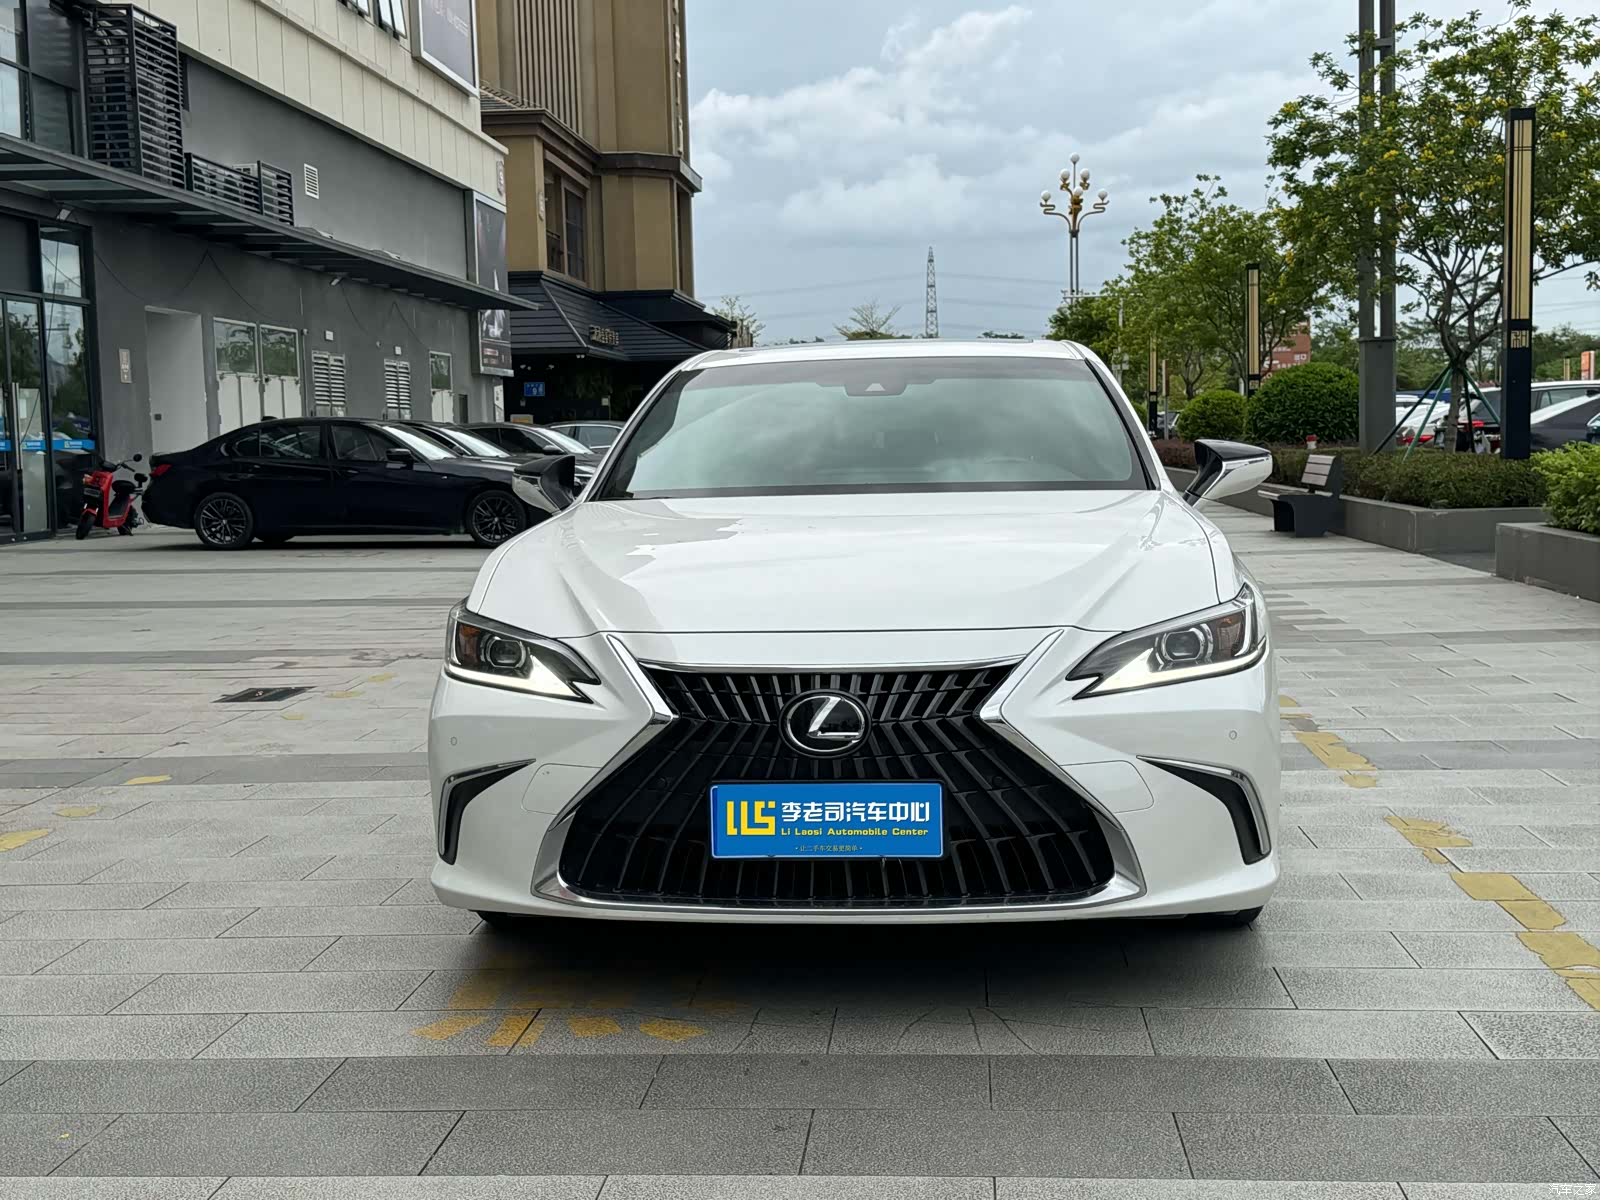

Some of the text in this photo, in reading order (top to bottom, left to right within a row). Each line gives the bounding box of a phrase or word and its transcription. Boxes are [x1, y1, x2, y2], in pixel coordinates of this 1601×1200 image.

[781, 801, 930, 822] 李老司汽车中心
[781, 828, 929, 836] Li Laosi Automobile Center
